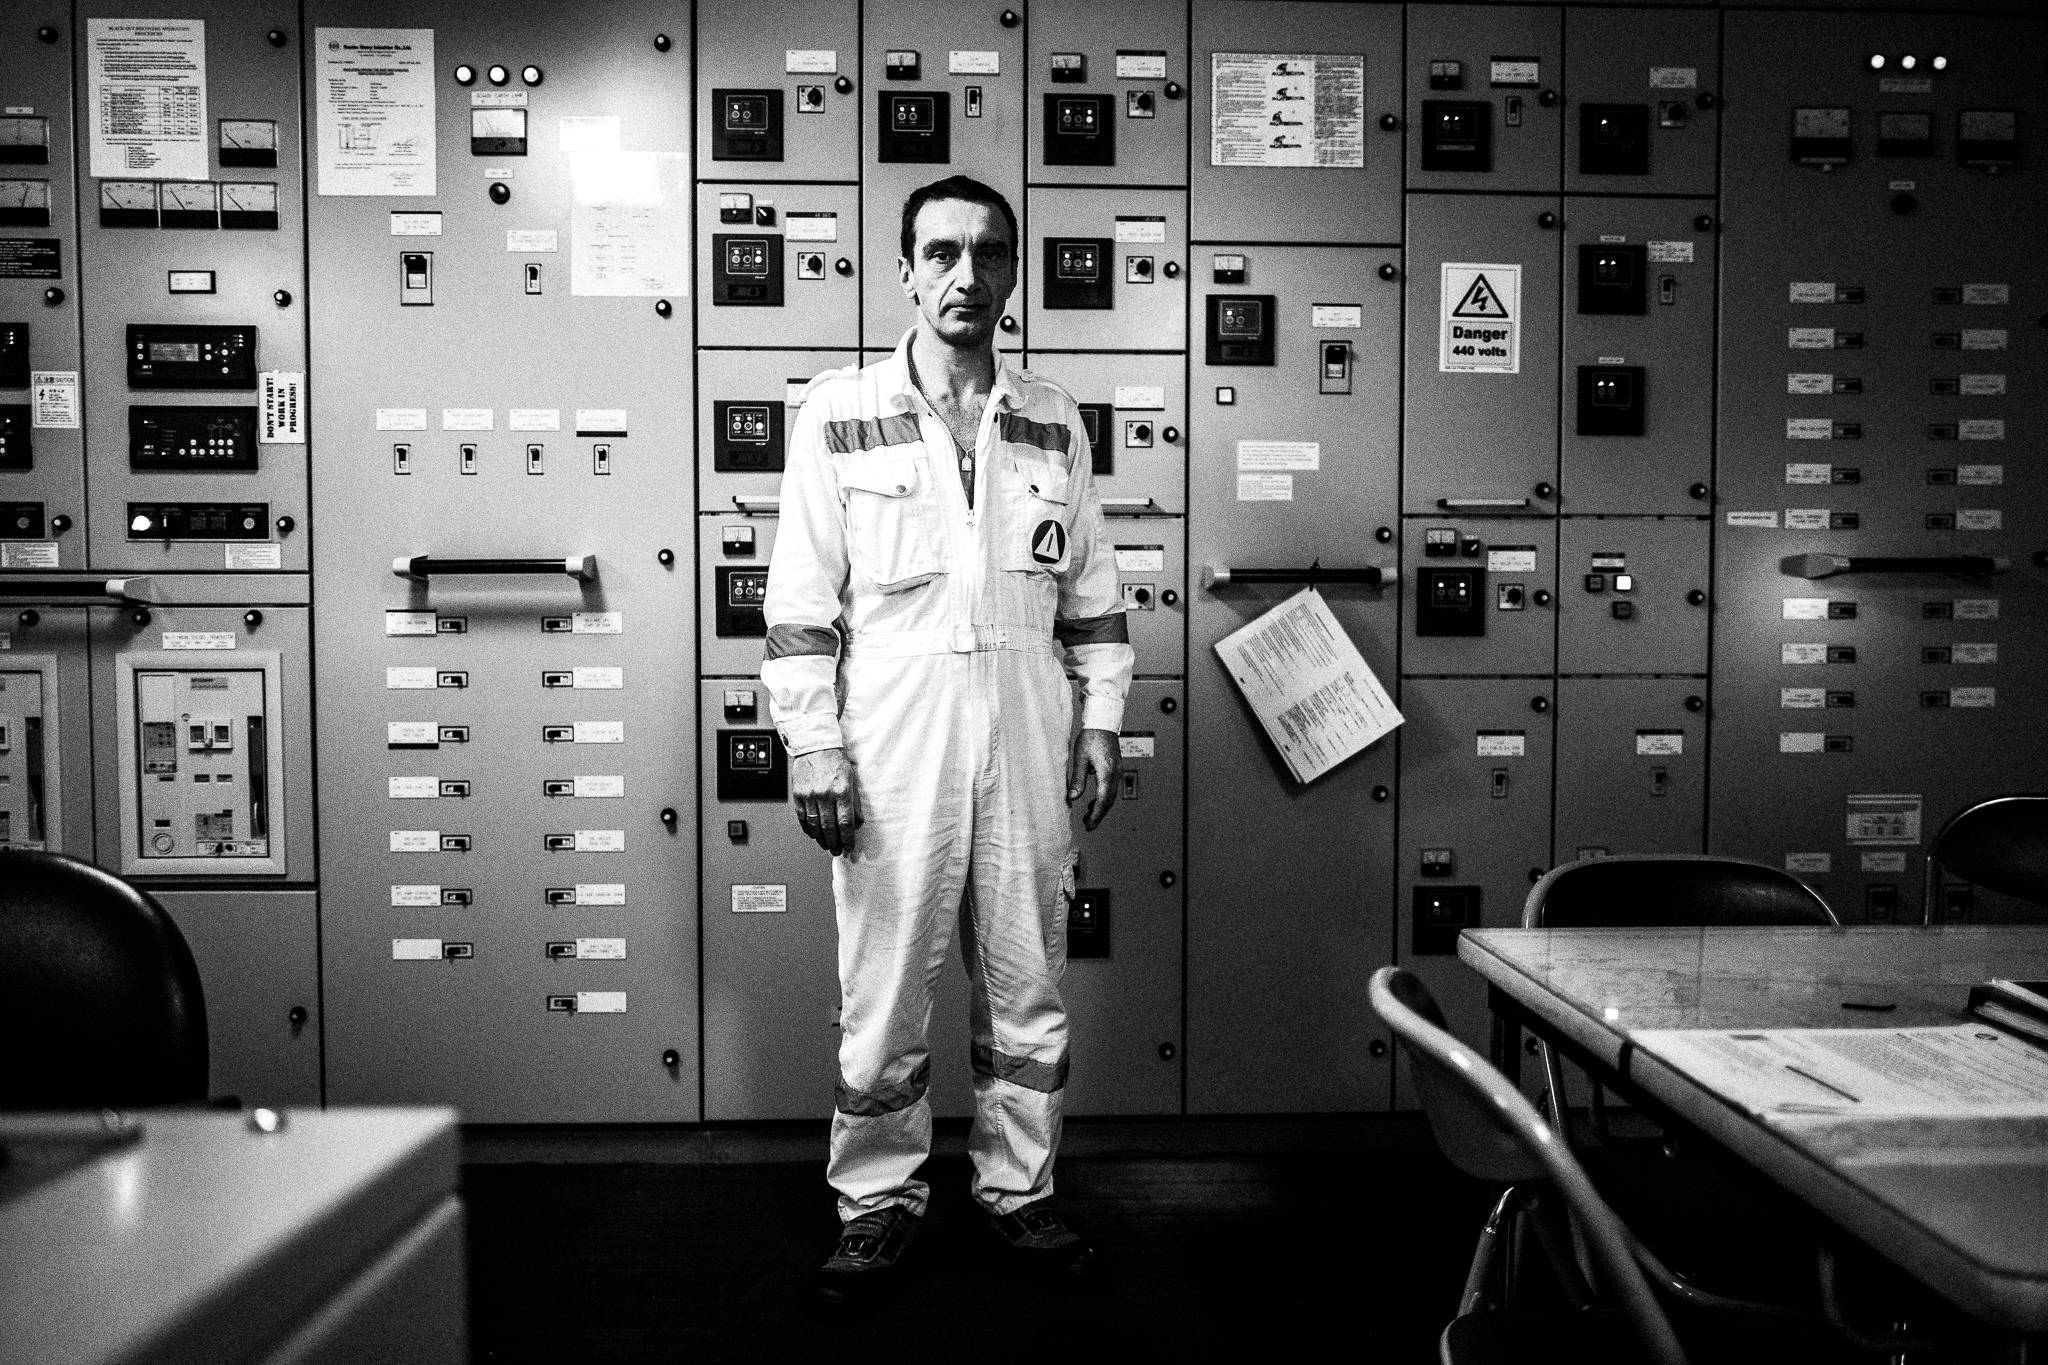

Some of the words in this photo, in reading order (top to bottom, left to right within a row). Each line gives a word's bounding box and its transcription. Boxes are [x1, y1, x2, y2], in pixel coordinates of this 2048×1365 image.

[1453, 326, 1508, 343] Danger
[1452, 346, 1475, 356] 440
[1478, 347, 1507, 357] volts
[266, 377, 274, 410] START!
[278, 388, 285, 398] IN
[289, 383, 297, 433] PROGRESS!
[266, 412, 275, 438] DON'T
